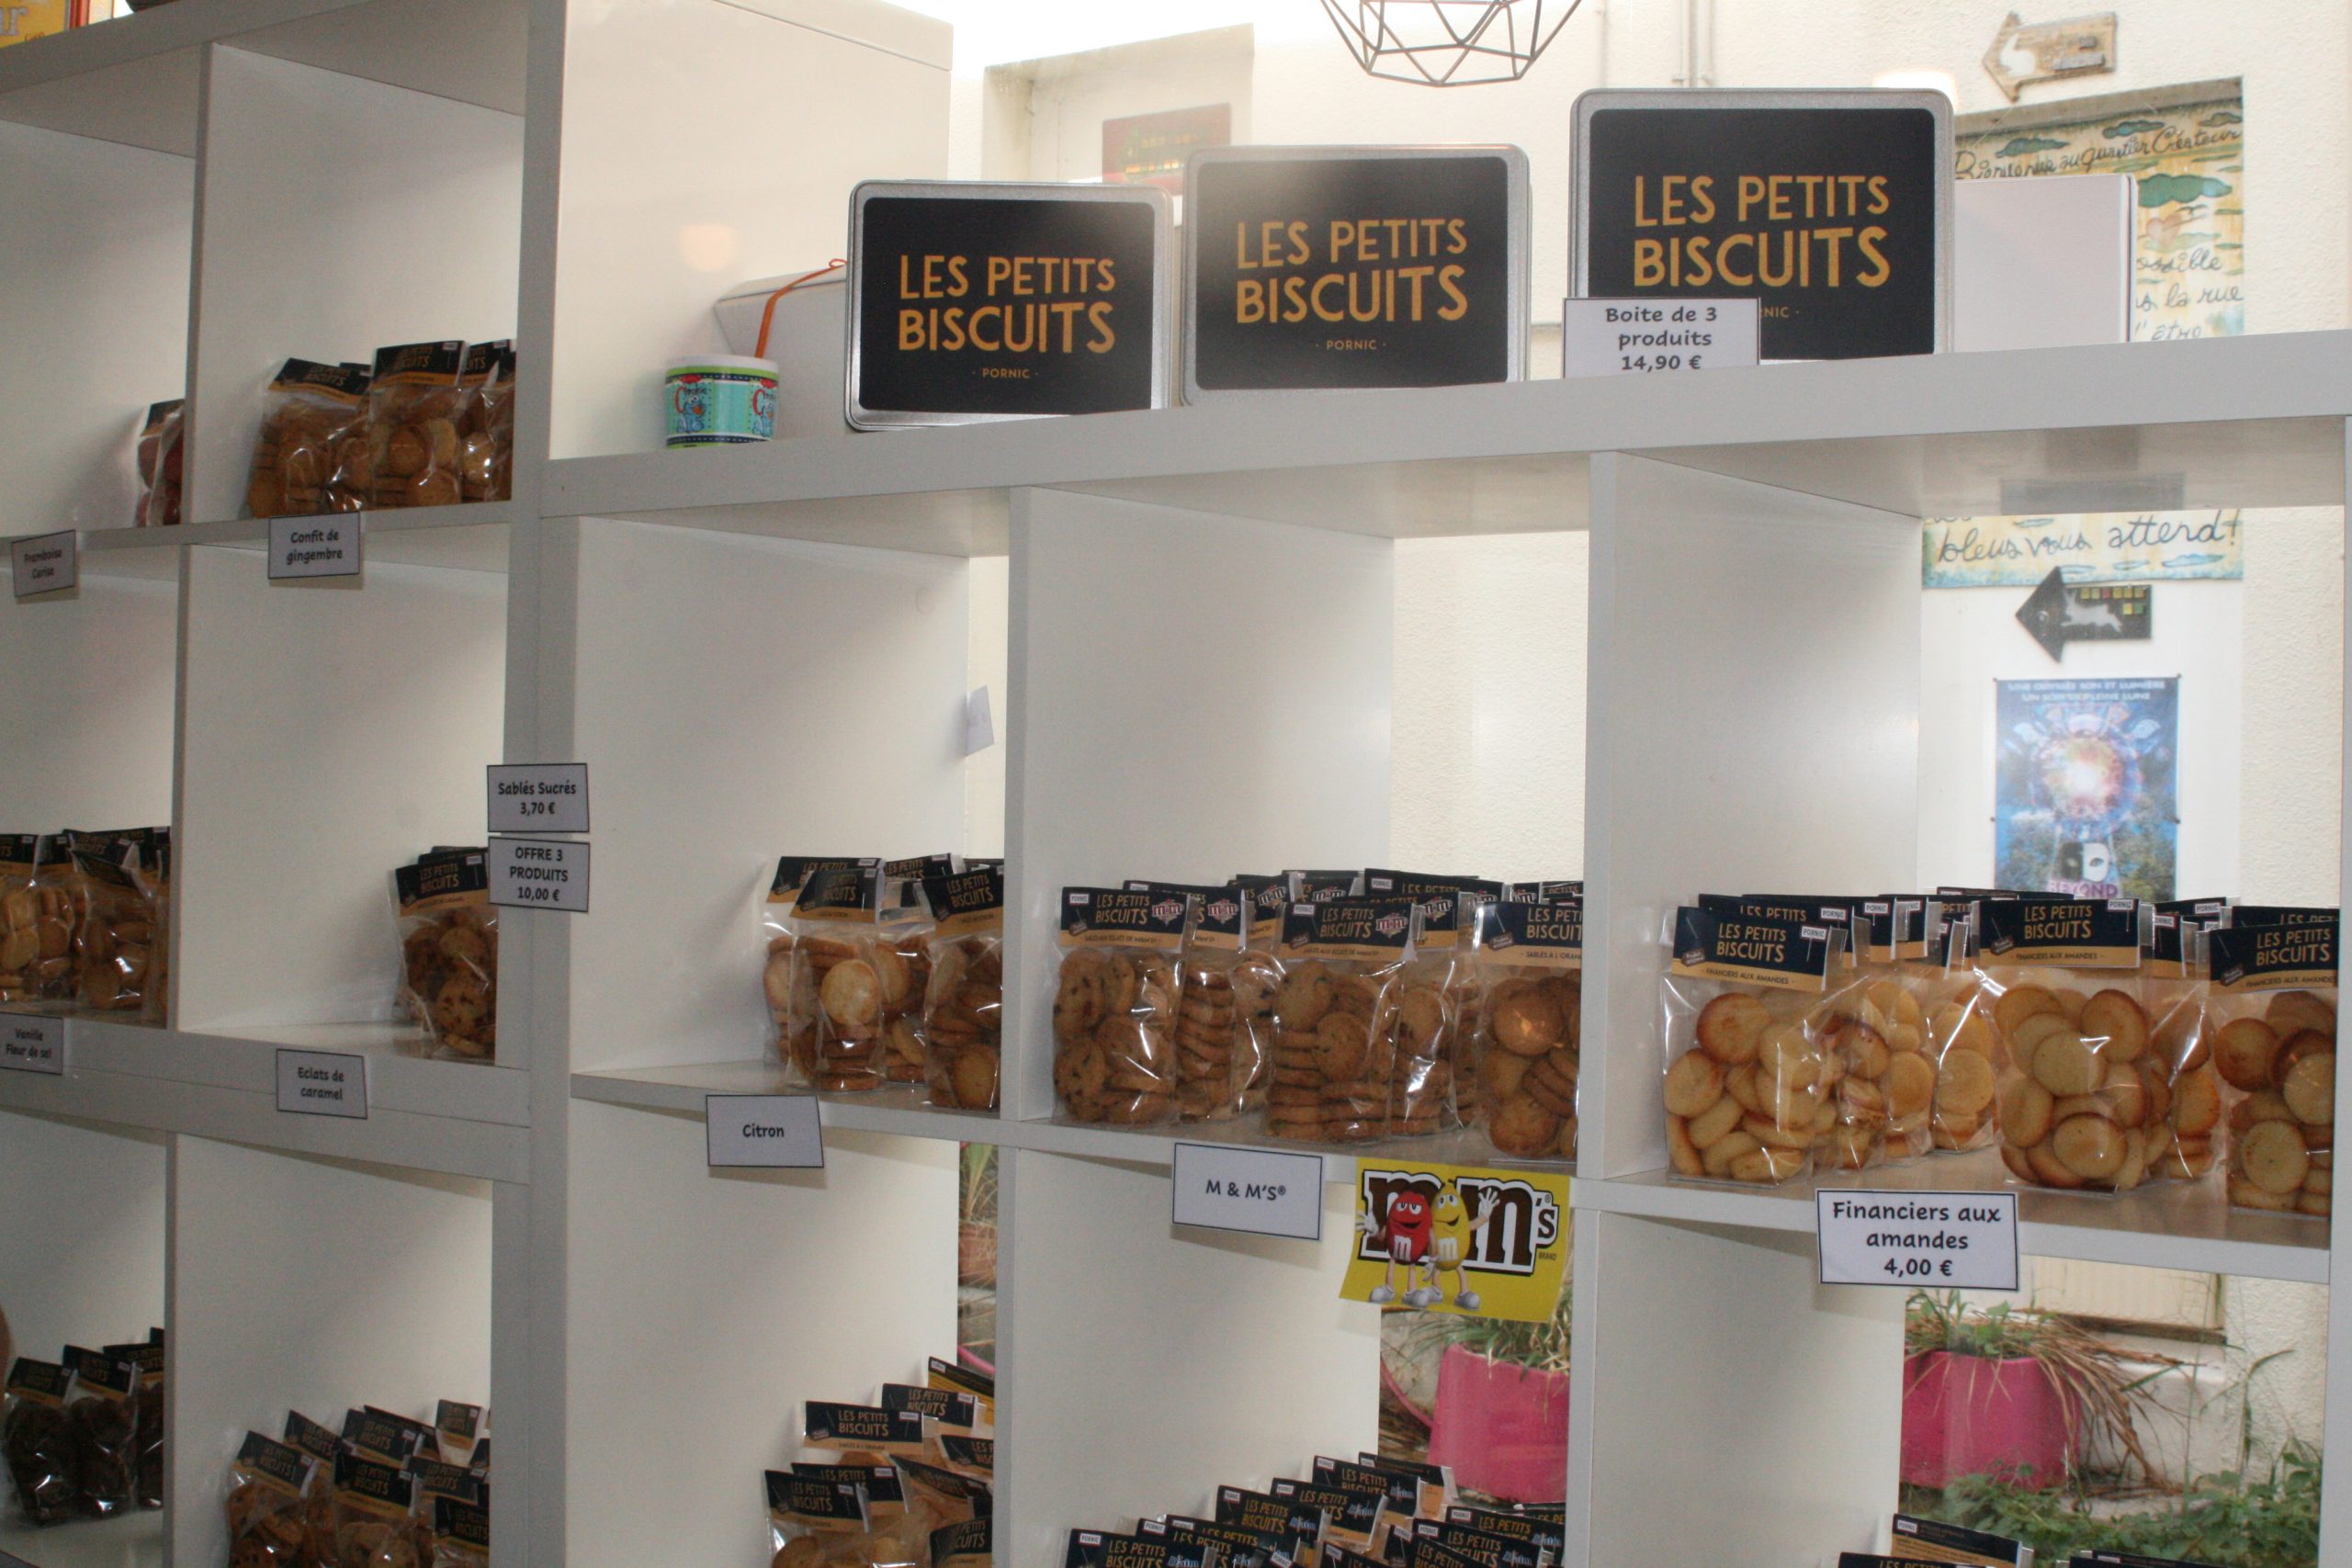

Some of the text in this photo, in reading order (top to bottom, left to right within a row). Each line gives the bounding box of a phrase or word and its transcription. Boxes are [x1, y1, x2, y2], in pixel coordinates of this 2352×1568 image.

[1635, 175, 1889, 227] LES PETITS
[1238, 219, 1468, 269] LES PETITS
[1634, 227, 1891, 288] BISCUITS
[2135, 248, 2222, 273] ossible
[900, 255, 1116, 299] LES PETITS
[1237, 265, 1468, 323] BISCUITS
[2198, 286, 2244, 304] rue
[1606, 307, 1717, 322] Boite de 3
[899, 302, 1116, 354] BISCUITS
[1327, 340, 1377, 350] PORNIC
[1619, 331, 1712, 351] produits
[1622, 355, 1702, 372] 14,90 €
[982, 368, 1030, 379] PORNIC
[290, 530, 339, 543] Confit de
[24, 549, 62, 564] Framboise
[286, 548, 343, 565] gingembre
[498, 780, 576, 795] Sablés Sucrés
[520, 802, 555, 817] 3,70 €
[515, 847, 563, 862] OFFRE 3
[509, 865, 568, 882] PRODUITS
[517, 886, 560, 901] 10,00 €
[1097, 894, 1150, 908] LES PETITS
[1095, 908, 1148, 925] BISCUITS
[1323, 908, 1374, 922] LES PETITS
[1528, 908, 1550, 922] LES
[1740, 905, 1807, 922] LES PETITS
[1822, 909, 1844, 919] PORNIC
[2024, 906, 2093, 922] LES PETITS
[1319, 921, 1373, 939] BISCUITS
[1718, 922, 1787, 942] LES PETITS
[1803, 928, 1826, 937] PORNIC
[2023, 919, 2092, 941] BISCUITS
[2256, 928, 2332, 949] LES PETITS
[1716, 942, 1786, 964] BISCUITS
[2256, 943, 2331, 967] BISCUITS
[1706, 968, 1738, 978] FINANCIERS
[1756, 975, 1790, 985] AMANDES
[15, 1028, 43, 1042] Vanille
[6, 1043, 51, 1059] Fleur de sel
[298, 1067, 345, 1083] Eclats de
[300, 1086, 343, 1101] caramel
[742, 1122, 785, 1137] Citron
[1205, 1179, 1221, 1195] M
[1227, 1181, 1239, 1197] &
[1833, 1201, 2001, 1223] Financiers aux
[1866, 1231, 1969, 1249] amandes
[1538, 1251, 1557, 1262] BRAND
[1884, 1258, 1953, 1278] 4,00 €
[838, 1410, 888, 1423] LES PETITS
[838, 1422, 889, 1437] BISCUITS
[1341, 1469, 1388, 1486] LES PETITS
[1299, 1490, 1349, 1506] LES PETITS
[1245, 1499, 1289, 1517] LES PETITS
[1241, 1516, 1286, 1535] BISCUITS
[1479, 1517, 1532, 1535] LES PETITS
[1108, 1539, 1167, 1559] LES PETITS
[1447, 1531, 1503, 1551] LES PETITS
